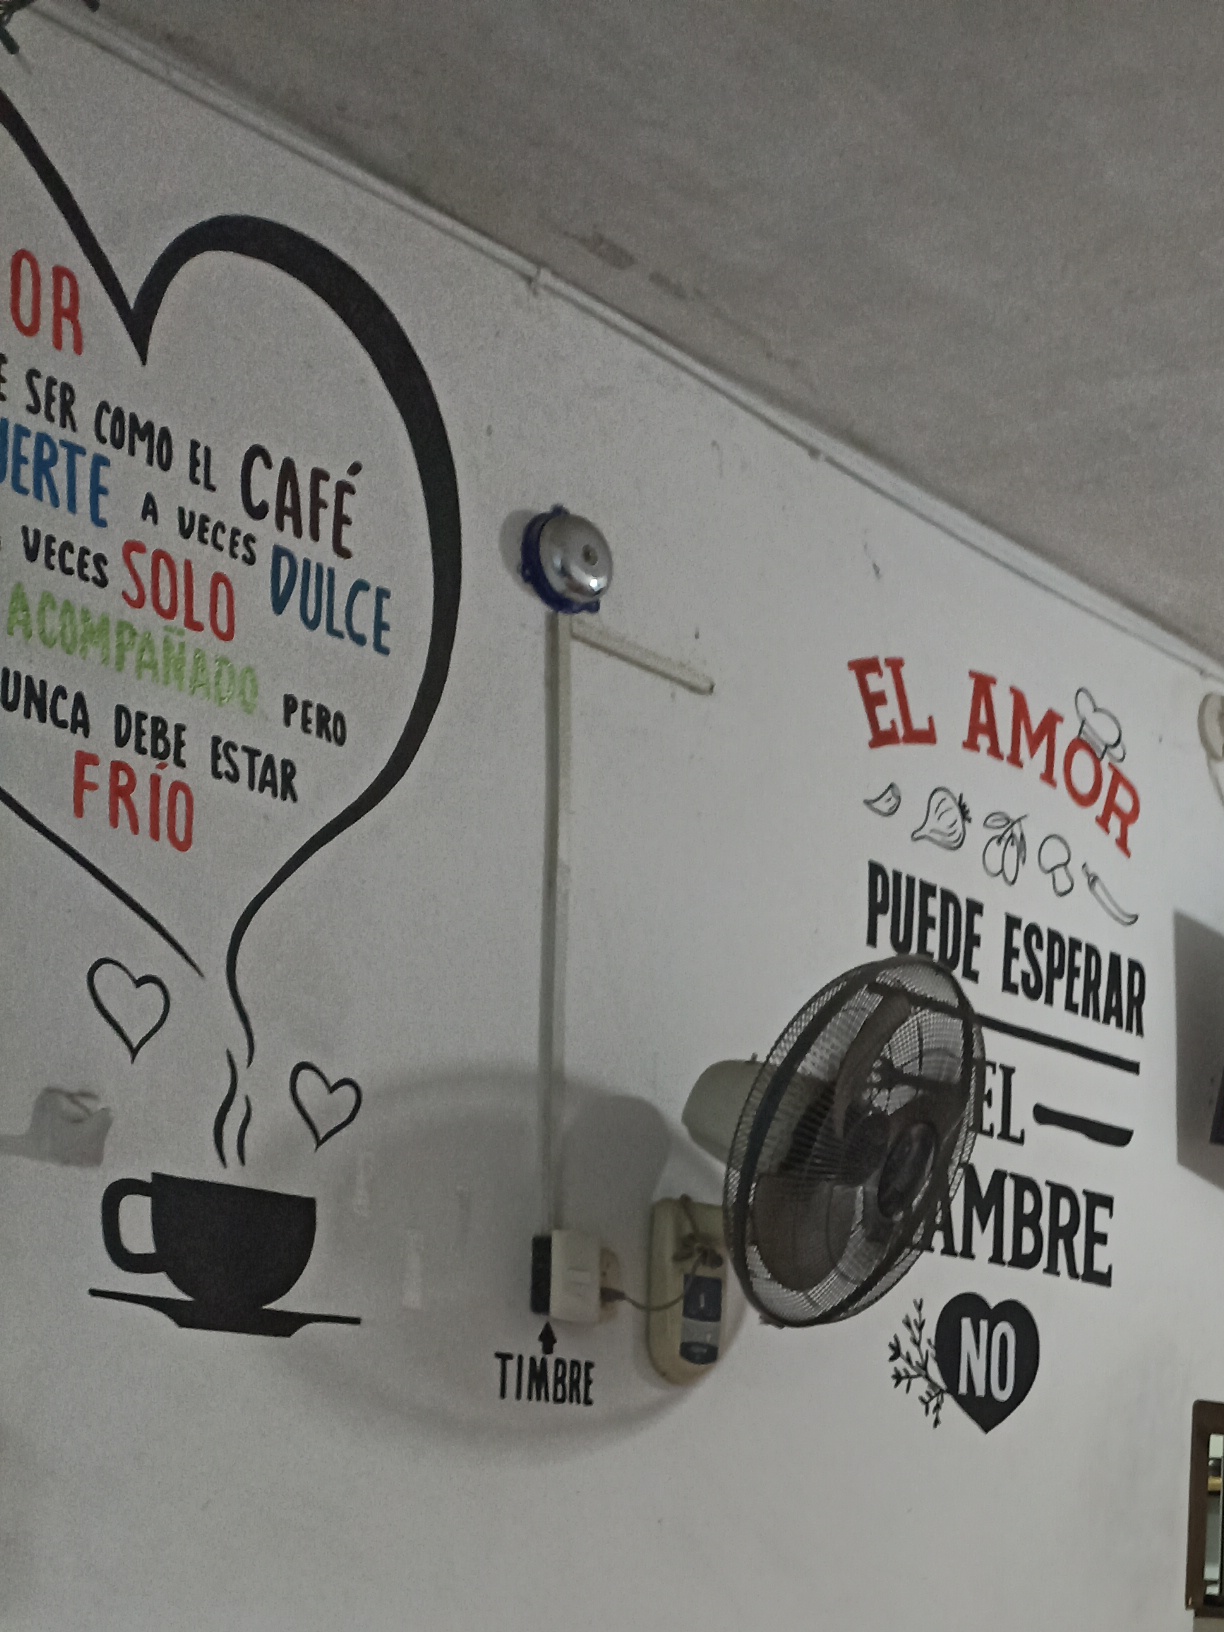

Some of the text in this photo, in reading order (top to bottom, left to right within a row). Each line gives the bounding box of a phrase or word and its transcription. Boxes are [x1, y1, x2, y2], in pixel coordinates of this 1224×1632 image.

[11, 250, 82, 355] OR
[25, 367, 77, 433] SER
[92, 400, 173, 472] COMO
[189, 439, 217, 493] EL
[240, 444, 363, 560] CAFÉ
[21, 525, 234, 641] VECES SOLO
[141, 492, 158, 526] A
[178, 506, 257, 566] VECES
[271, 544, 391, 657] DULCE
[7, 582, 347, 747] ACOMPAÑADO PERO
[74, 751, 193, 852] FRÍO
[114, 704, 187, 769] DEBE
[211, 735, 298, 803] ESTAR
[848, 658, 1139, 855] EL AMOR
[866, 859, 1145, 1037] PUEDE ESPERAR
[975, 1058, 1025, 1146] EL
[917, 1163, 1114, 1288] AMBRE
[494, 1351, 595, 1407] TIMBRE
[958, 1316, 1016, 1403] NO
